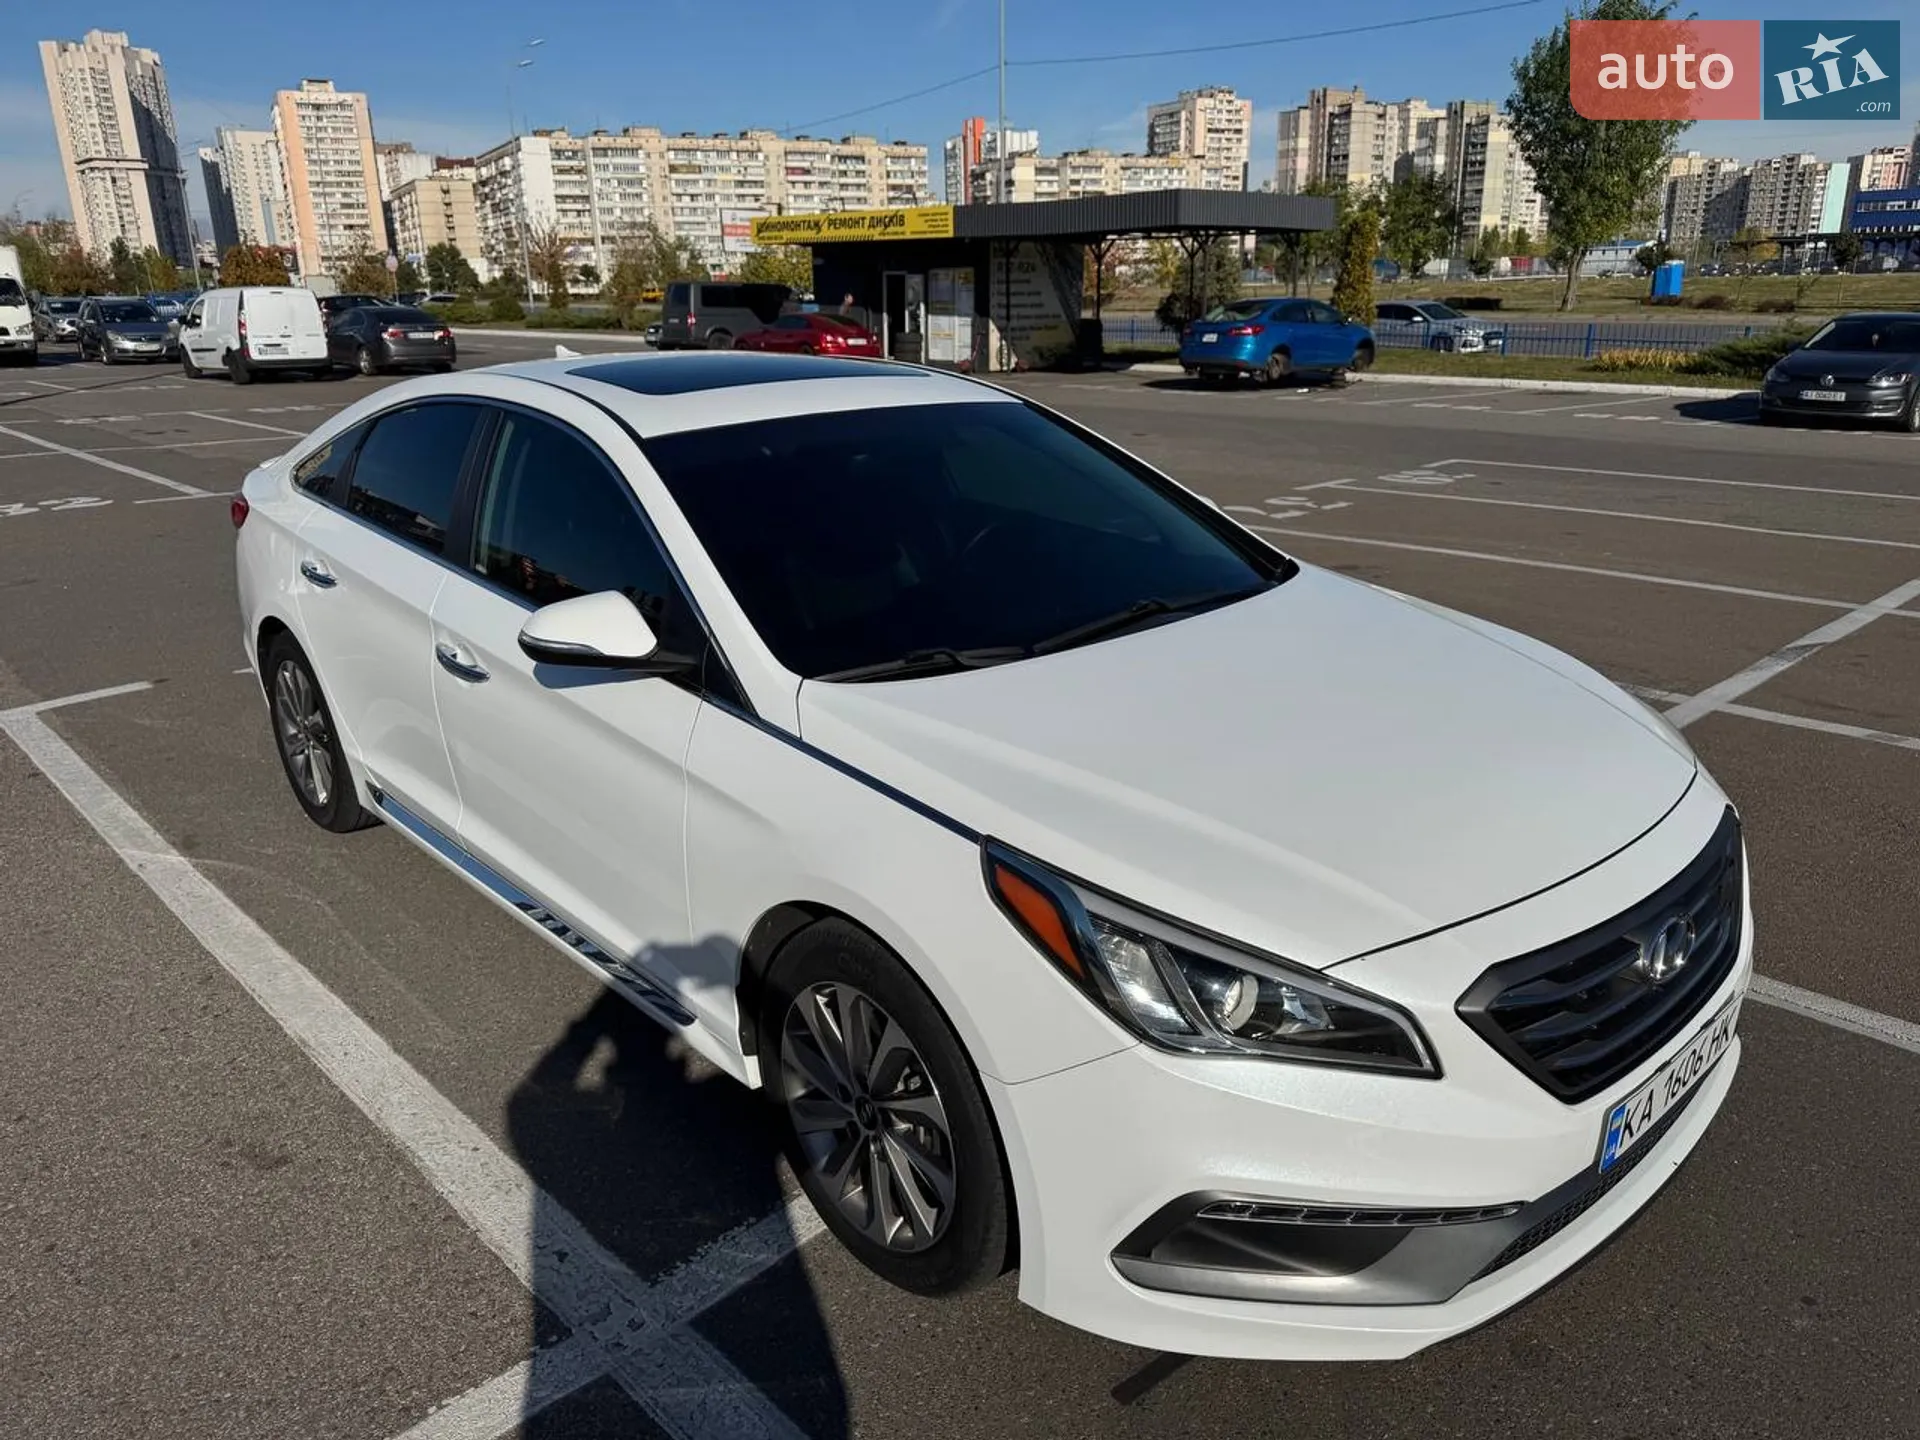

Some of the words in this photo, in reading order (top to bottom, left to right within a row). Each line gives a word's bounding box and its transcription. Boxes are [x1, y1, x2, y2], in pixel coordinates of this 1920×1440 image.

[827, 216, 867, 229] РЕМОНТ
[867, 213, 905, 230] ДИСКІВ
[1618, 1088, 1654, 1149] KA
[1663, 1036, 1707, 1108] 1606
